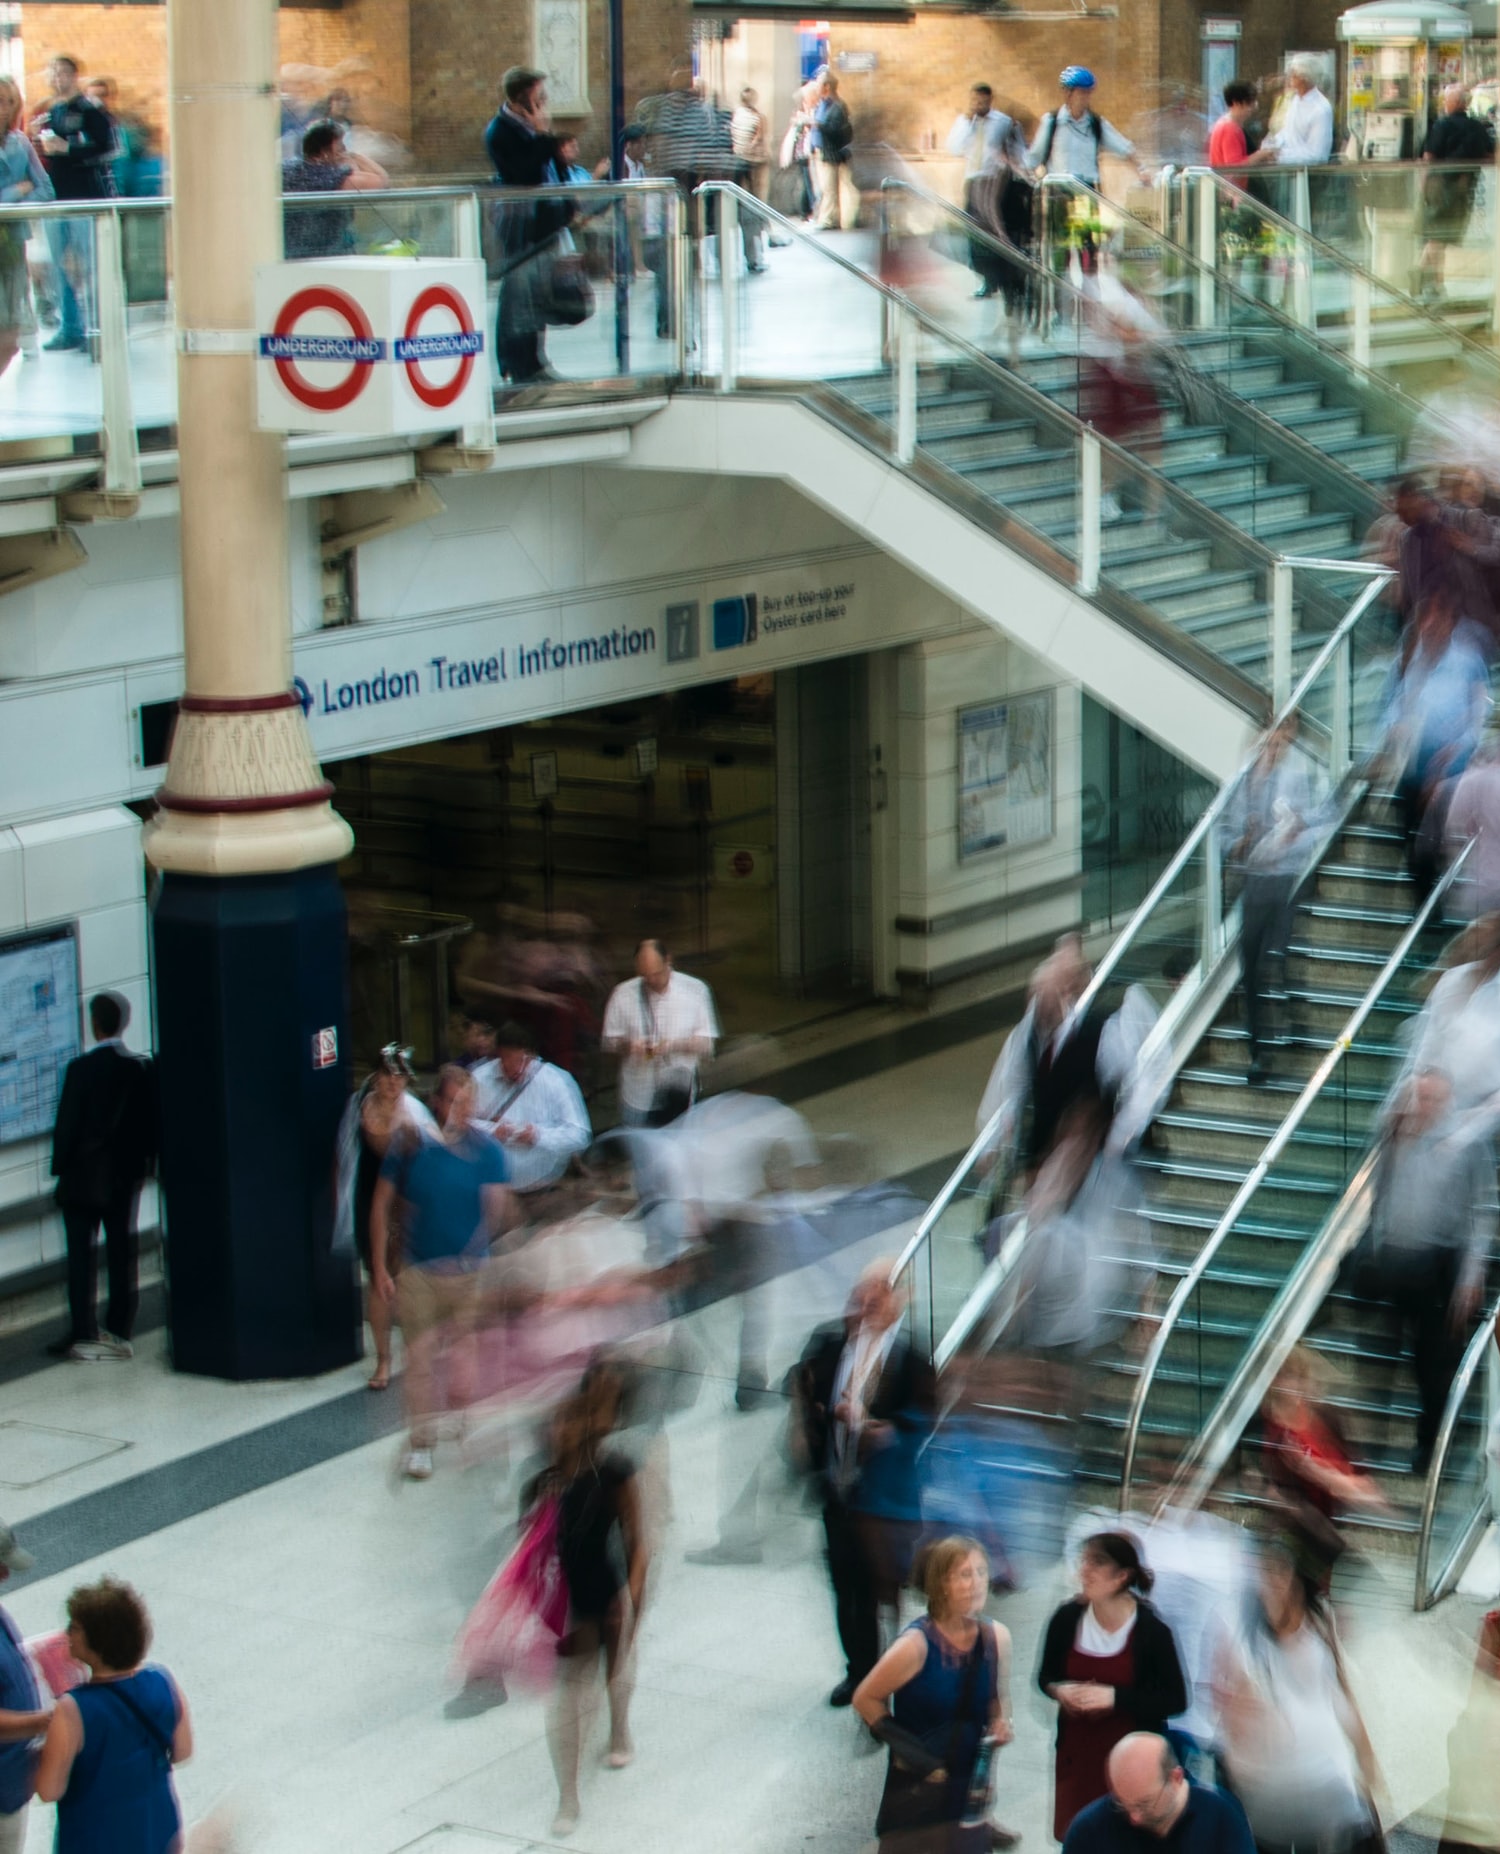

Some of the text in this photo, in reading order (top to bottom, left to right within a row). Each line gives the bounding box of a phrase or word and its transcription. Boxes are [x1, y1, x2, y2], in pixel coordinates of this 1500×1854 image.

[267, 338, 380, 356] UNDERGROUND
[399, 334, 479, 355] UNDERGROUND
[763, 613, 798, 633] Oyster
[322, 624, 655, 714] London Travel Information
